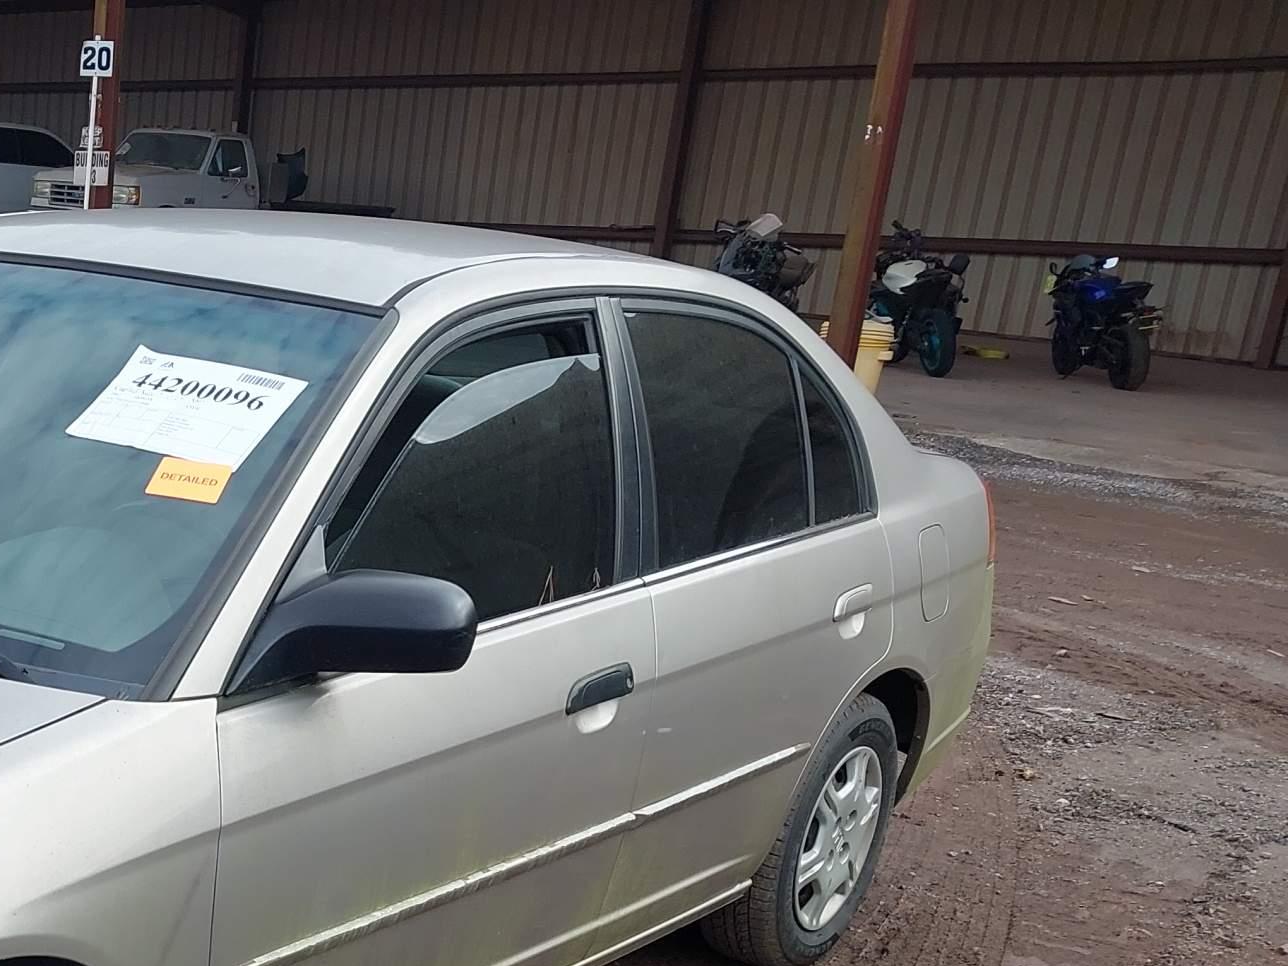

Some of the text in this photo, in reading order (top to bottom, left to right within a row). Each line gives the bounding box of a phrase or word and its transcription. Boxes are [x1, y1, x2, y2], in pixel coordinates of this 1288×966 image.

[82, 46, 111, 71] 20
[75, 152, 109, 168] BUIDING
[132, 372, 271, 412] 44200096
[160, 471, 219, 488] DETAILED
